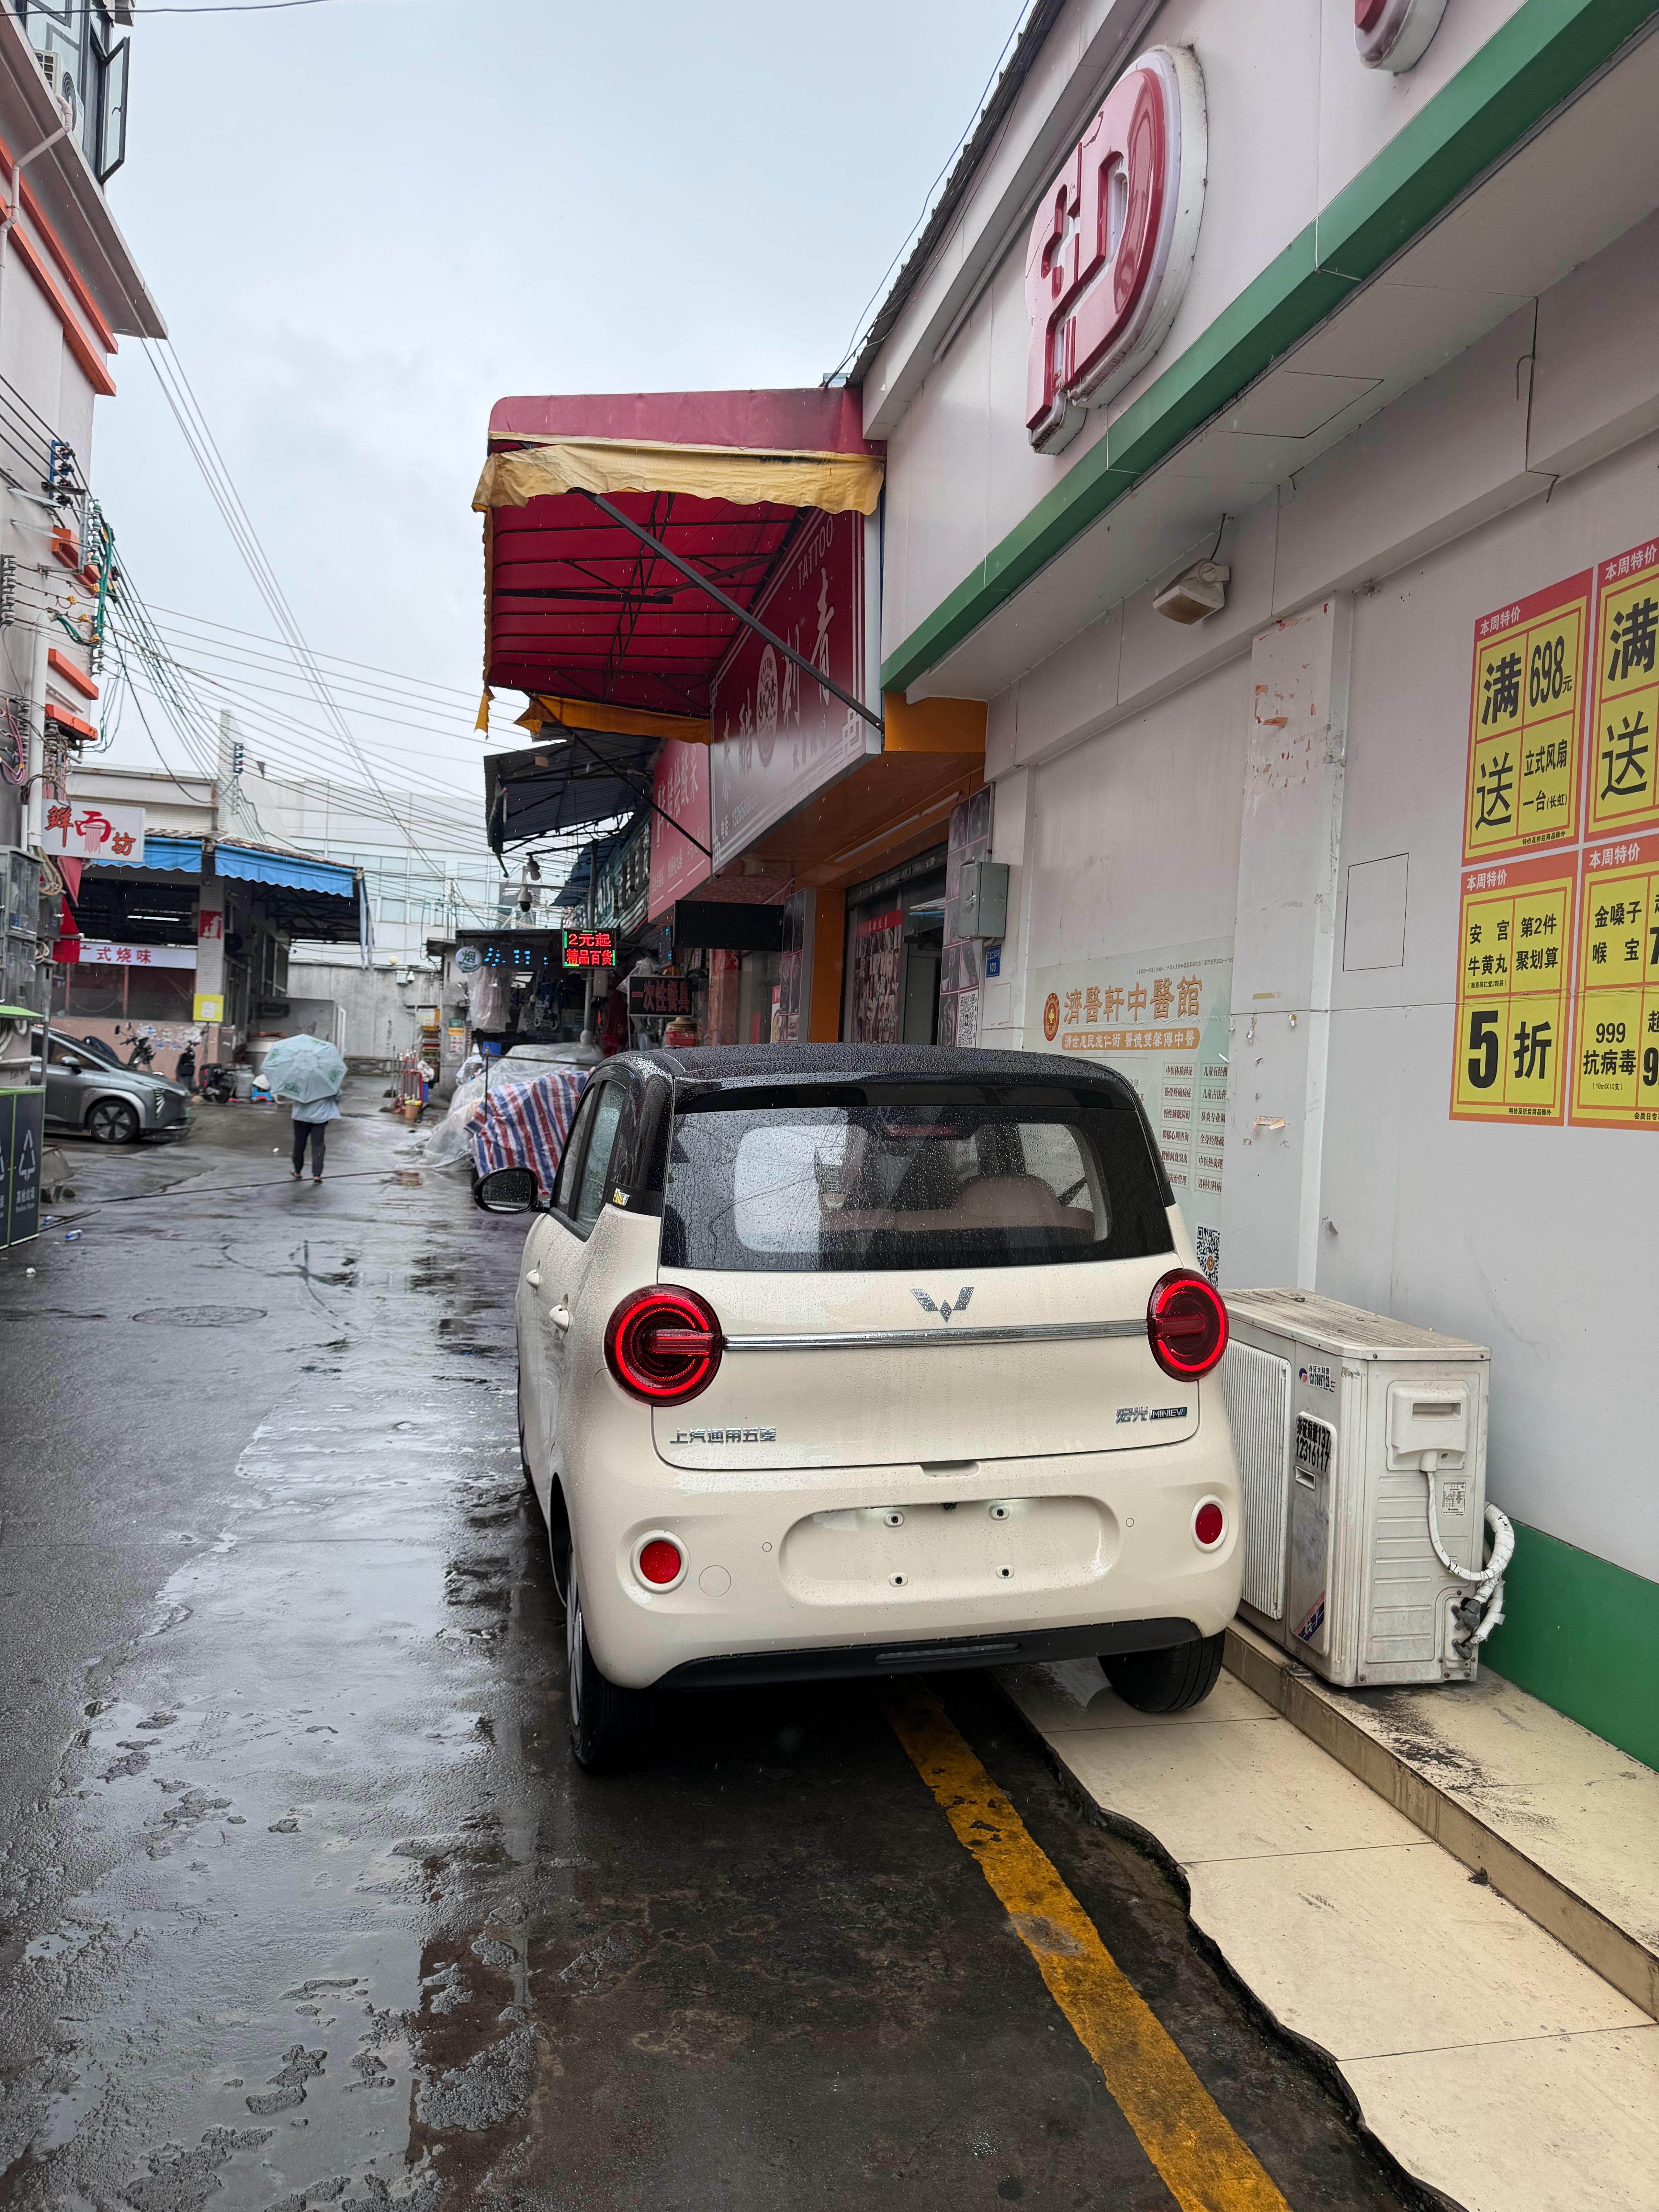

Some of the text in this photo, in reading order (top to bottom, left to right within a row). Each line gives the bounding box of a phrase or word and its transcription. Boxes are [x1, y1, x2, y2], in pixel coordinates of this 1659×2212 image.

[798, 515, 833, 591] TATTOO
[1605, 544, 1657, 580] 本周特价
[1480, 605, 1521, 636] 本周特价
[1607, 597, 1659, 682] 满
[1481, 636, 1572, 725] 满 698元
[1524, 739, 1568, 776] 立式风扇
[1600, 711, 1648, 801] 送
[1474, 752, 1513, 831] 送
[1523, 790, 1567, 812] 一台(长虹)
[44, 805, 136, 856] 鲜面坊
[1522, 830, 1566, 846] 特价及折后商品除外
[1589, 842, 1640, 869] 本周特价
[1467, 869, 1507, 891] 本周特价
[1520, 913, 1557, 938] 第2件
[1594, 901, 1642, 928] 金嗓子
[568, 933, 611, 947] 2元起
[567, 949, 613, 965] 精品百货
[1468, 953, 1508, 976] 牛黄丸
[1515, 946, 1559, 972] 聚划算
[631, 980, 690, 1013] 一次性餐具
[1064, 974, 1202, 1024] 濟醫軒中醫館
[1595, 1022, 1626, 1044] 999
[1468, 1010, 1552, 1089] 5 折
[1583, 1049, 1637, 1076] 抗病毒
[1509, 1107, 1551, 1116] 特价及折后商品除外
[1115, 1406, 1183, 1425] 宏光 MINIEV
[670, 1426, 776, 1444] 上汽通用五菱
[1296, 1435, 1329, 1473] 12316117
